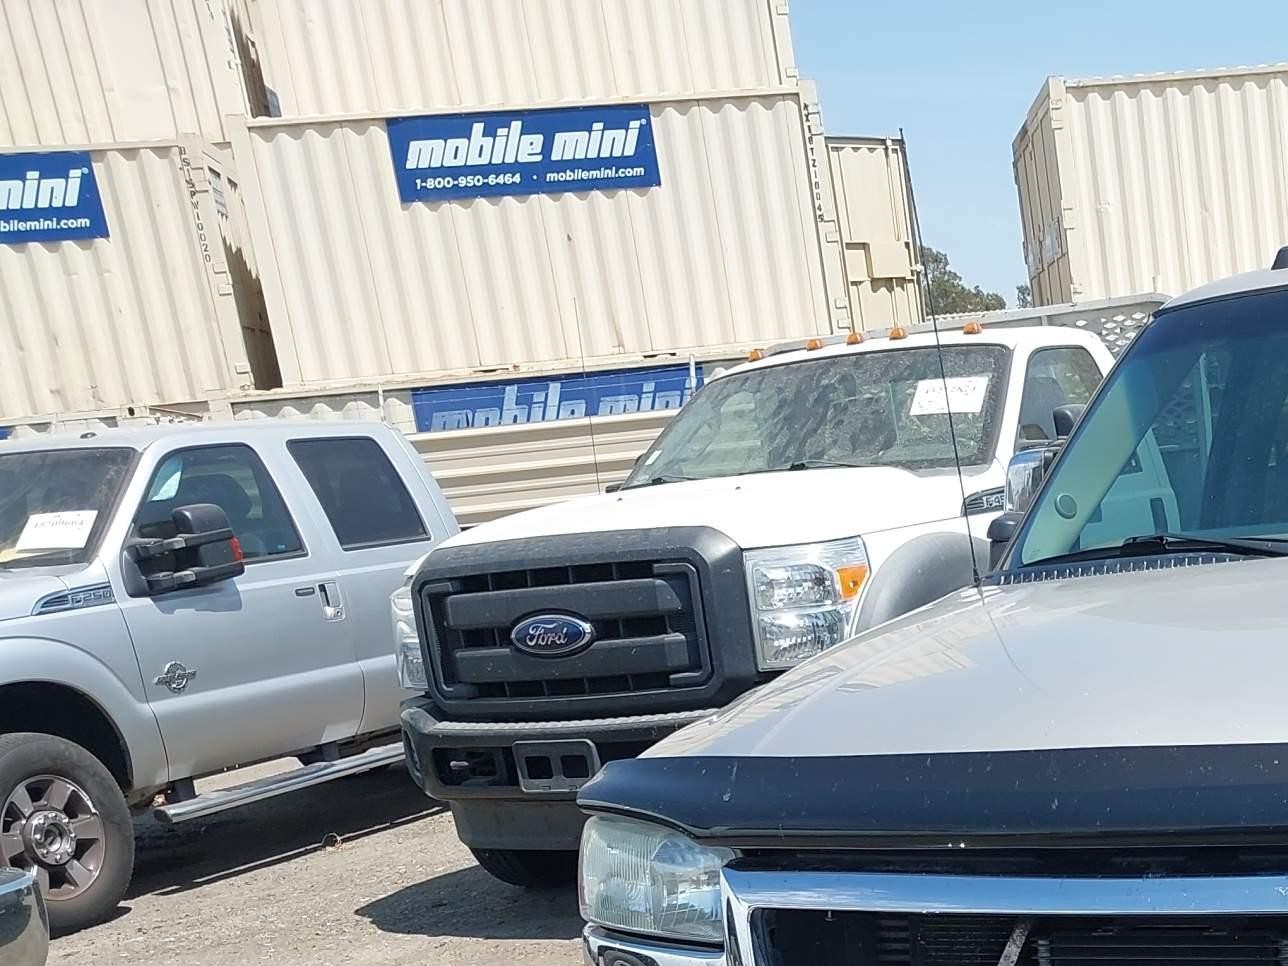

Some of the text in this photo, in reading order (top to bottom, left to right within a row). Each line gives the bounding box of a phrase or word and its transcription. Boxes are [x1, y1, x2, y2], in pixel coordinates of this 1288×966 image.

[405, 120, 641, 169] mobile mini
[415, 166, 645, 190] 1-800-950-6464 mobilemini.com
[430, 382, 587, 432] mobile
[526, 622, 568, 646] Ford
